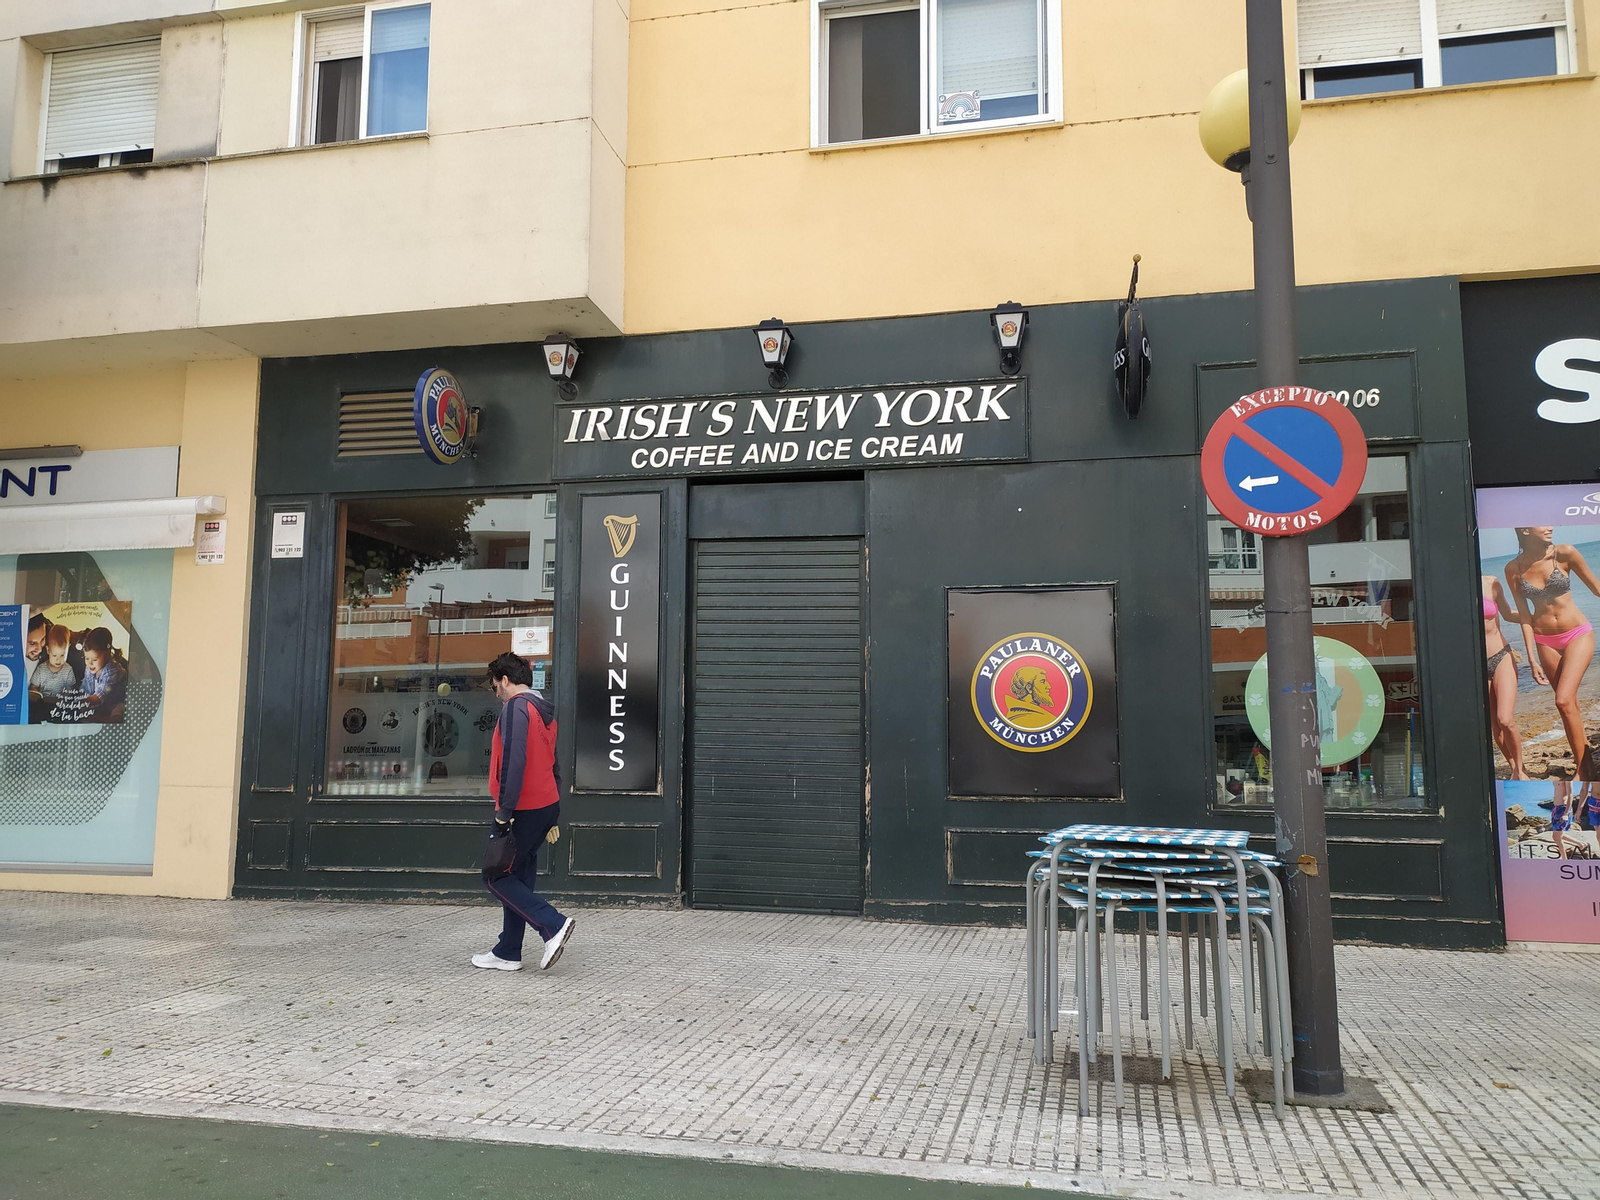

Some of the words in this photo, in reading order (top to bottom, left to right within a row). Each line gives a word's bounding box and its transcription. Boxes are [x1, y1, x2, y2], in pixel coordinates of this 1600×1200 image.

[563, 400, 737, 443] IRISH'S
[743, 393, 862, 434] NEW
[872, 383, 1017, 428] YORK
[1229, 386, 1328, 418] EXCEPTO
[631, 444, 735, 469] COFFEE
[741, 441, 799, 465] AND
[806, 438, 853, 461] ICE
[860, 432, 964, 459] CREAM
[0, 464, 72, 498] NT
[1245, 510, 1322, 531] MOTOS
[1565, 506, 1600, 516] O'N
[1313, 590, 1341, 608] EW
[607, 563, 630, 771] GUINNESS
[980, 638, 1081, 680] PAULANER
[50, 708, 61, 718] de
[73, 709, 95, 721] boca
[453, 701, 469, 716] YORK
[989, 717, 1075, 745] MÜNCHEN
[371, 745, 401, 754] MANZANAS
[1518, 844, 1562, 860] IT'S
